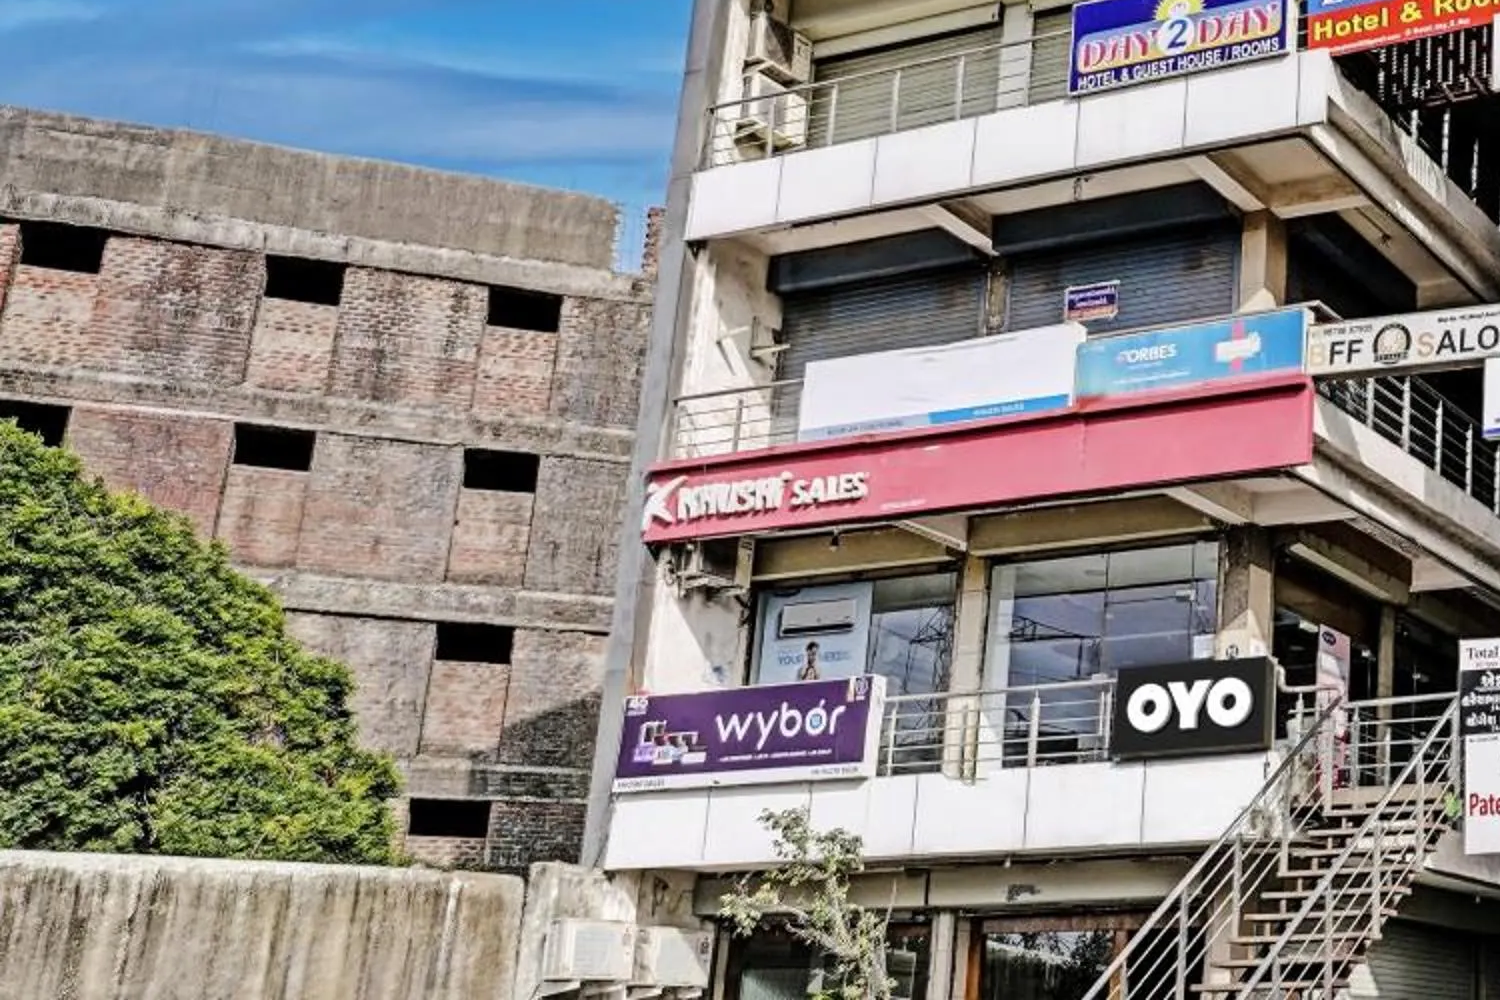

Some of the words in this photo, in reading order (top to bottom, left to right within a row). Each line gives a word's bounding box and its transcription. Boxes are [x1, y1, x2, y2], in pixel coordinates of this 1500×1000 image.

[1166, 18, 1190, 50] 2
[1199, 2, 1280, 45] DAY
[1313, 8, 1390, 41] Hotel
[1400, 0, 1423, 23] &
[1077, 74, 1118, 91] HOTEL
[1122, 68, 1132, 83] &
[1133, 58, 1176, 80] GUEST
[1177, 50, 1222, 73] HOUSE
[1231, 38, 1280, 60] ROOMS
[791, 471, 869, 507] SALES
[1465, 646, 1499, 660] Total
[1126, 676, 1253, 734] OYO
